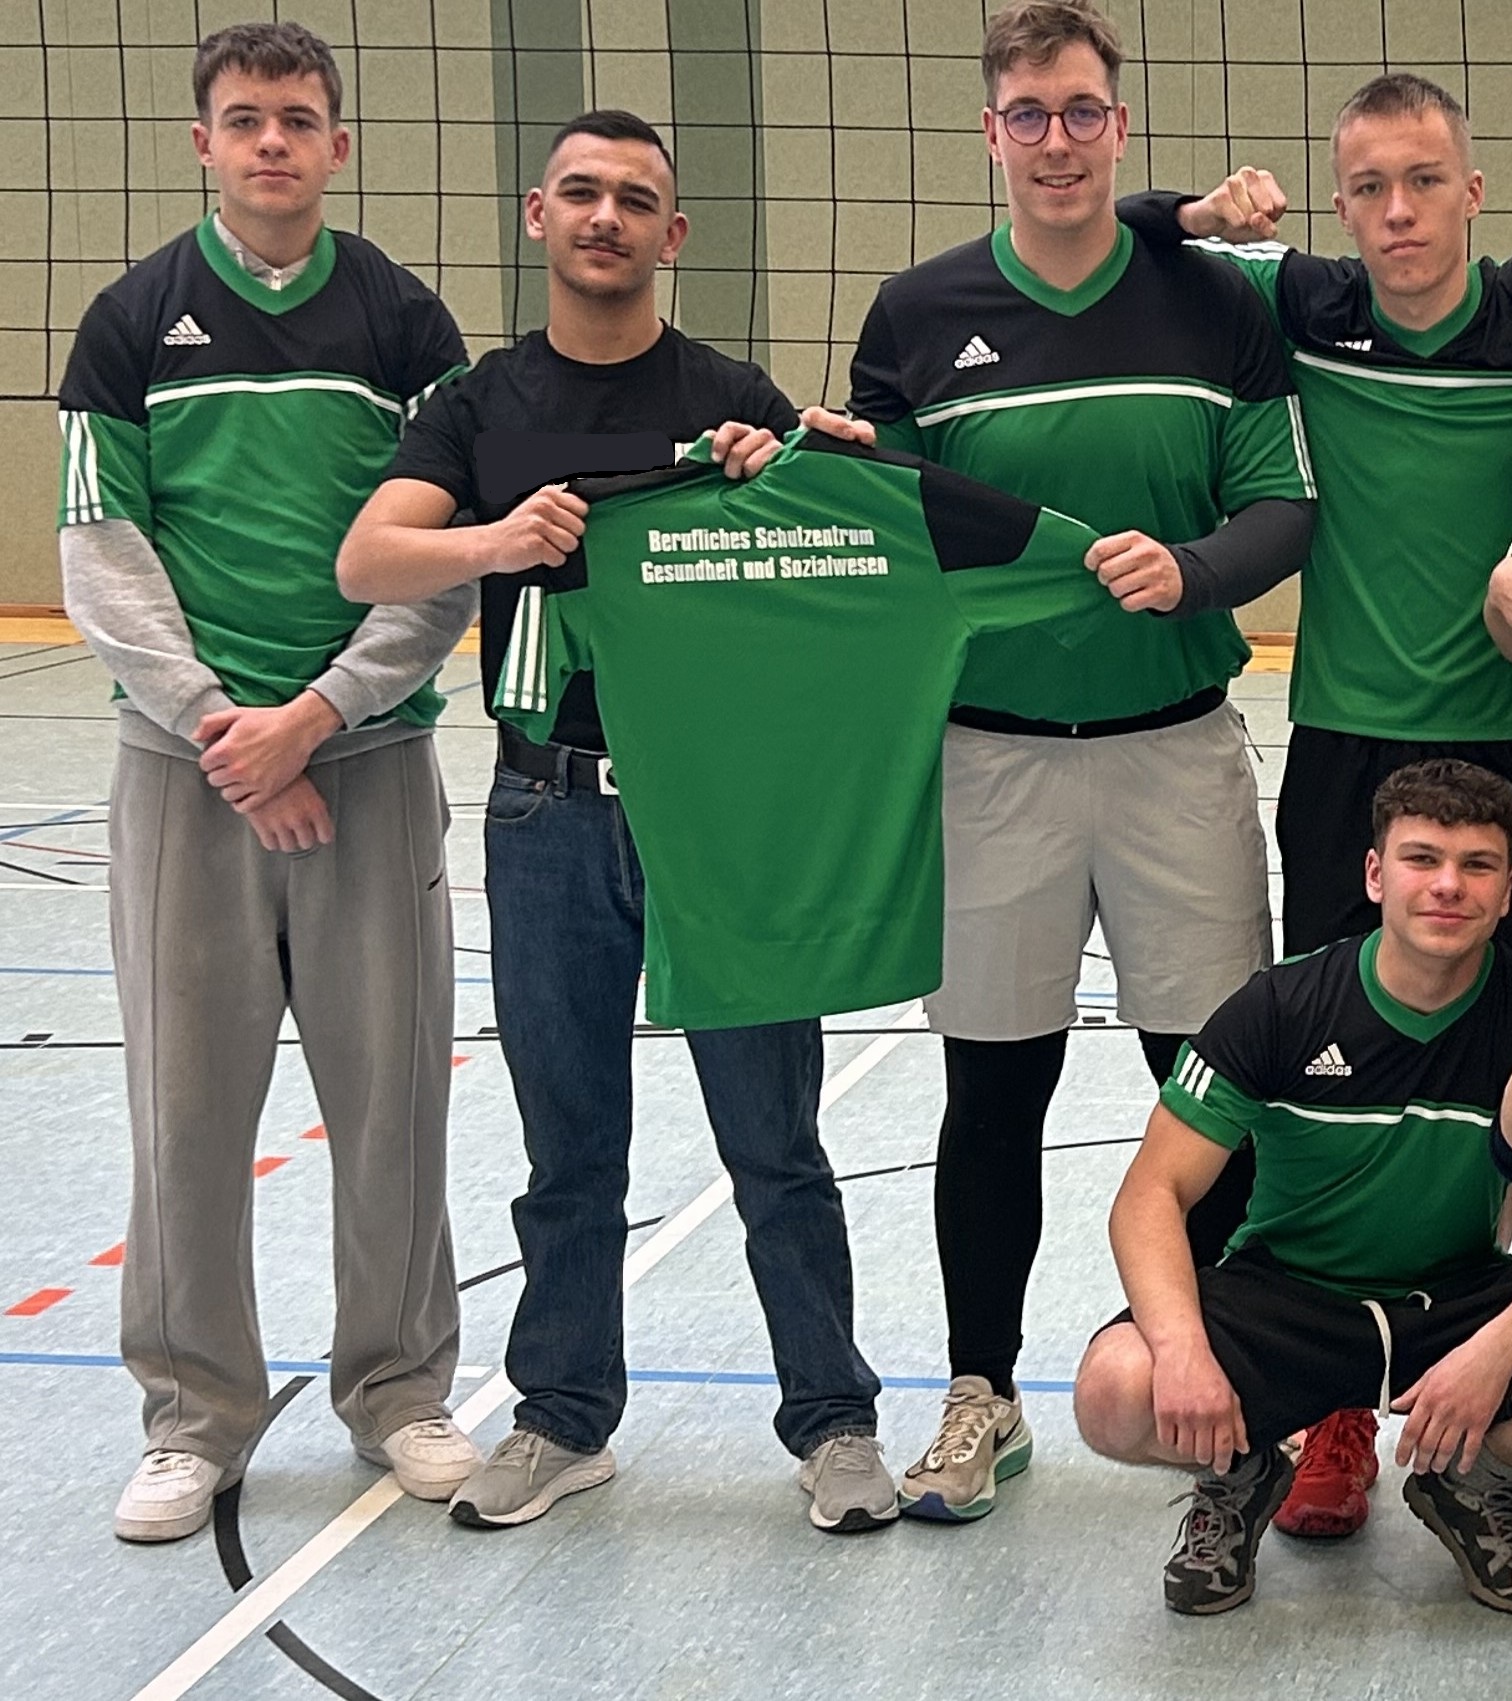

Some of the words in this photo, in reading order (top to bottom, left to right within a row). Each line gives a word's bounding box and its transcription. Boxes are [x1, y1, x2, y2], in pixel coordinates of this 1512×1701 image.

[163, 333, 212, 346] adidas
[954, 351, 1000, 369] adidas
[648, 528, 751, 552] Berufliches
[754, 525, 875, 549] Schulzentrum
[641, 558, 739, 584] Gesundheit
[743, 556, 775, 580] und
[779, 555, 889, 578] Sozialwesen
[1305, 1064, 1353, 1077] adidas
